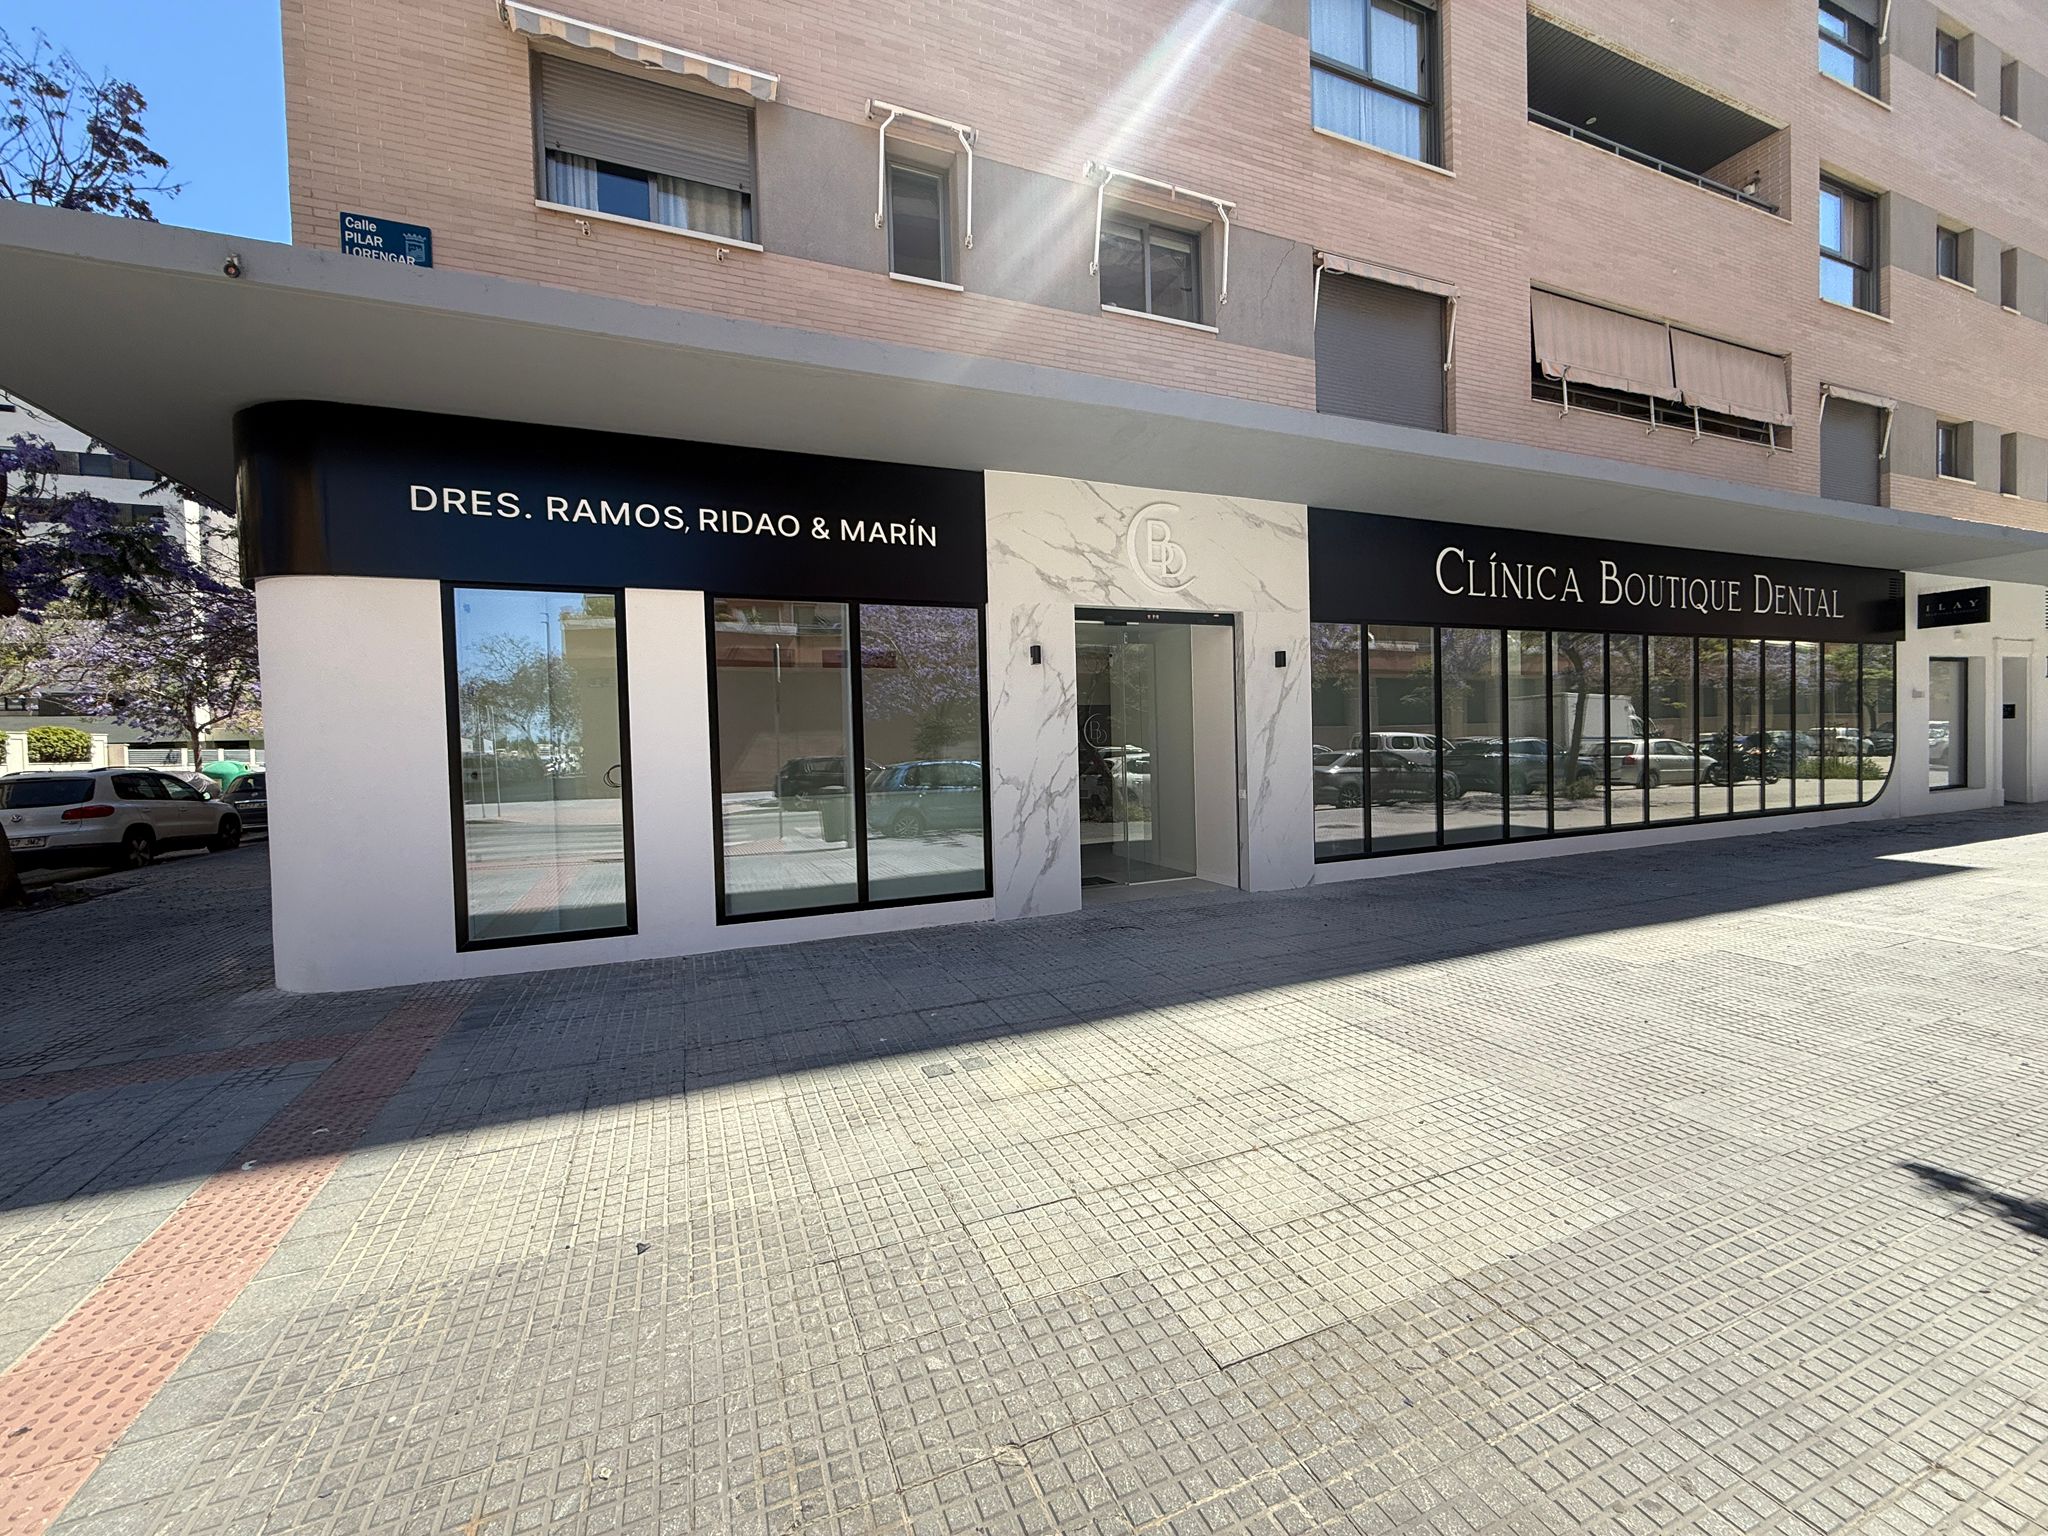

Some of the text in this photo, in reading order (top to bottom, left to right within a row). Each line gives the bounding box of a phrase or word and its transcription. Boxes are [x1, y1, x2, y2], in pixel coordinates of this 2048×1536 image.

[345, 216, 377, 232] Calle
[345, 231, 383, 248] PILAR
[345, 245, 416, 266] LORENGAR
[410, 484, 937, 547] DRES. RAMOS, RIDAO & MARÍN
